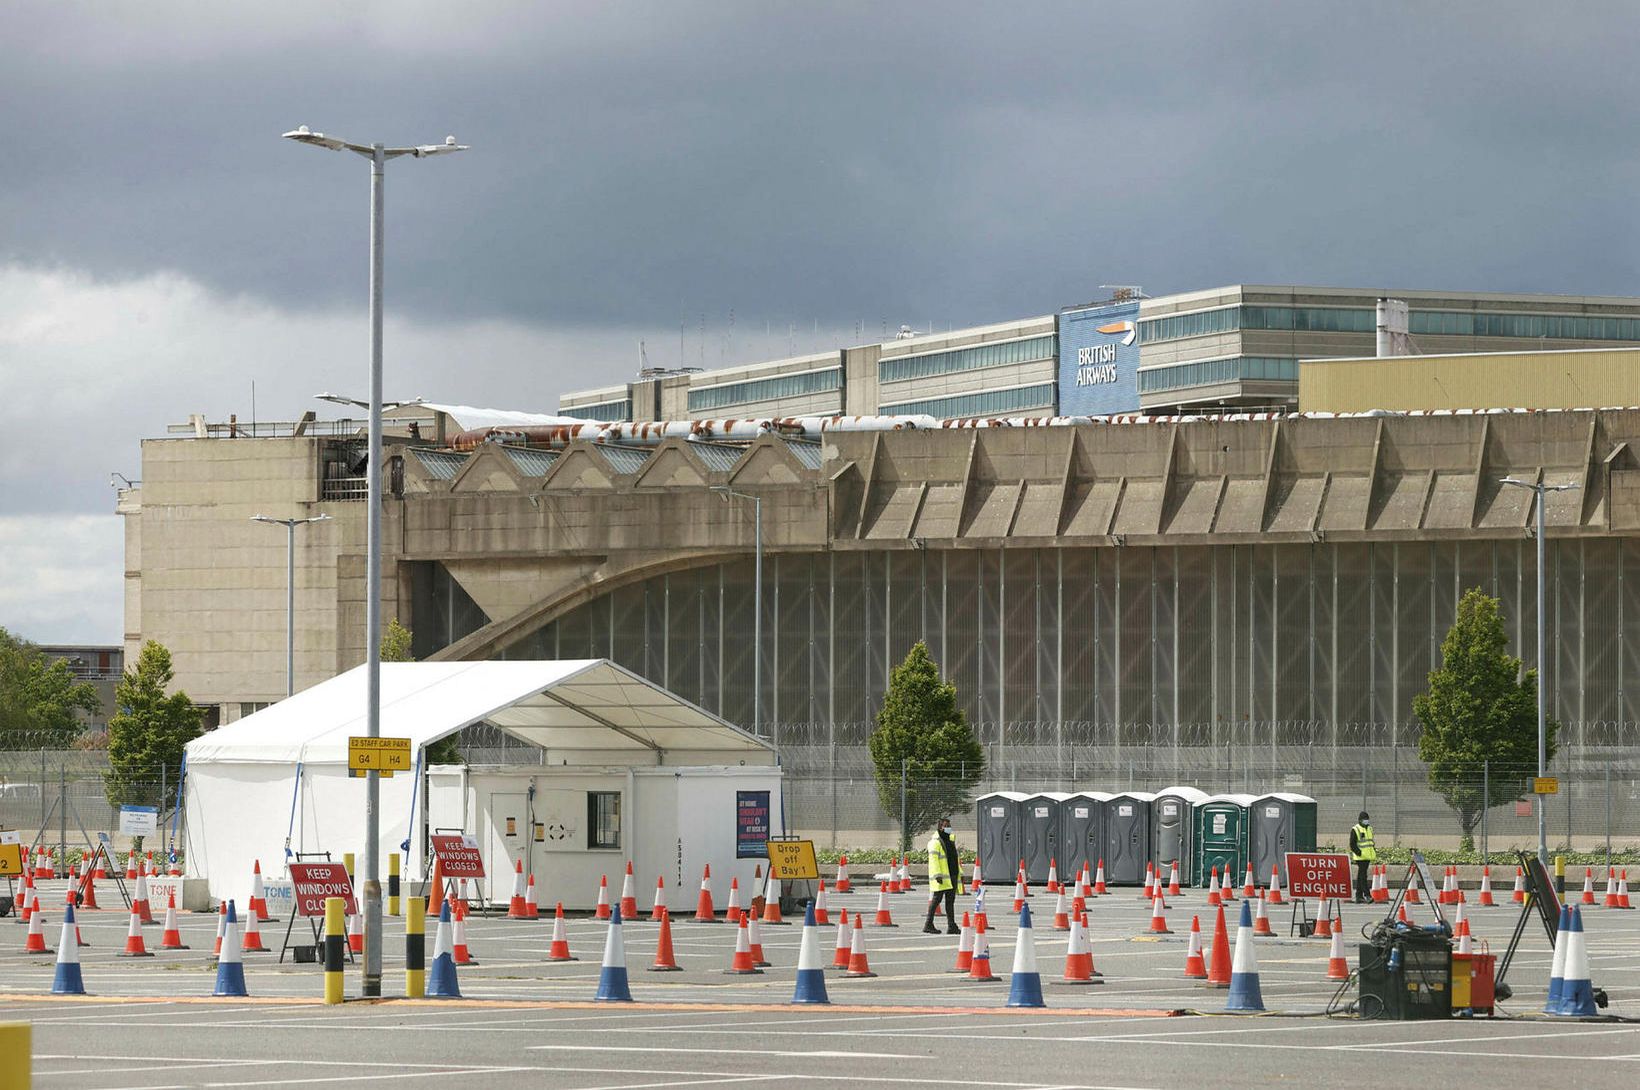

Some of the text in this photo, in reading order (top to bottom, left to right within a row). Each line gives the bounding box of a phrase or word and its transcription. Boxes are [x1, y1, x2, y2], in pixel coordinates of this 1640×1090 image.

[1078, 343, 1116, 366] BRITISH
[1076, 363, 1117, 387] AIRWAYS
[361, 739, 377, 747] STAFF
[379, 739, 391, 747] CAR
[392, 739, 408, 747] PARK
[358, 754, 370, 764] G4
[389, 755, 401, 764] H4
[777, 844, 801, 854] Drop
[437, 851, 480, 861] WINDOWS
[784, 854, 798, 864] off
[445, 861, 477, 871] CLOSED
[1300, 858, 1337, 868] TURN
[306, 868, 332, 880] KEEP
[1307, 870, 1332, 880] OFF
[150, 884, 177, 897] TONE
[263, 886, 292, 898] TONE
[297, 882, 350, 896] WINDOWS
[1294, 882, 1347, 894] ENGINE
